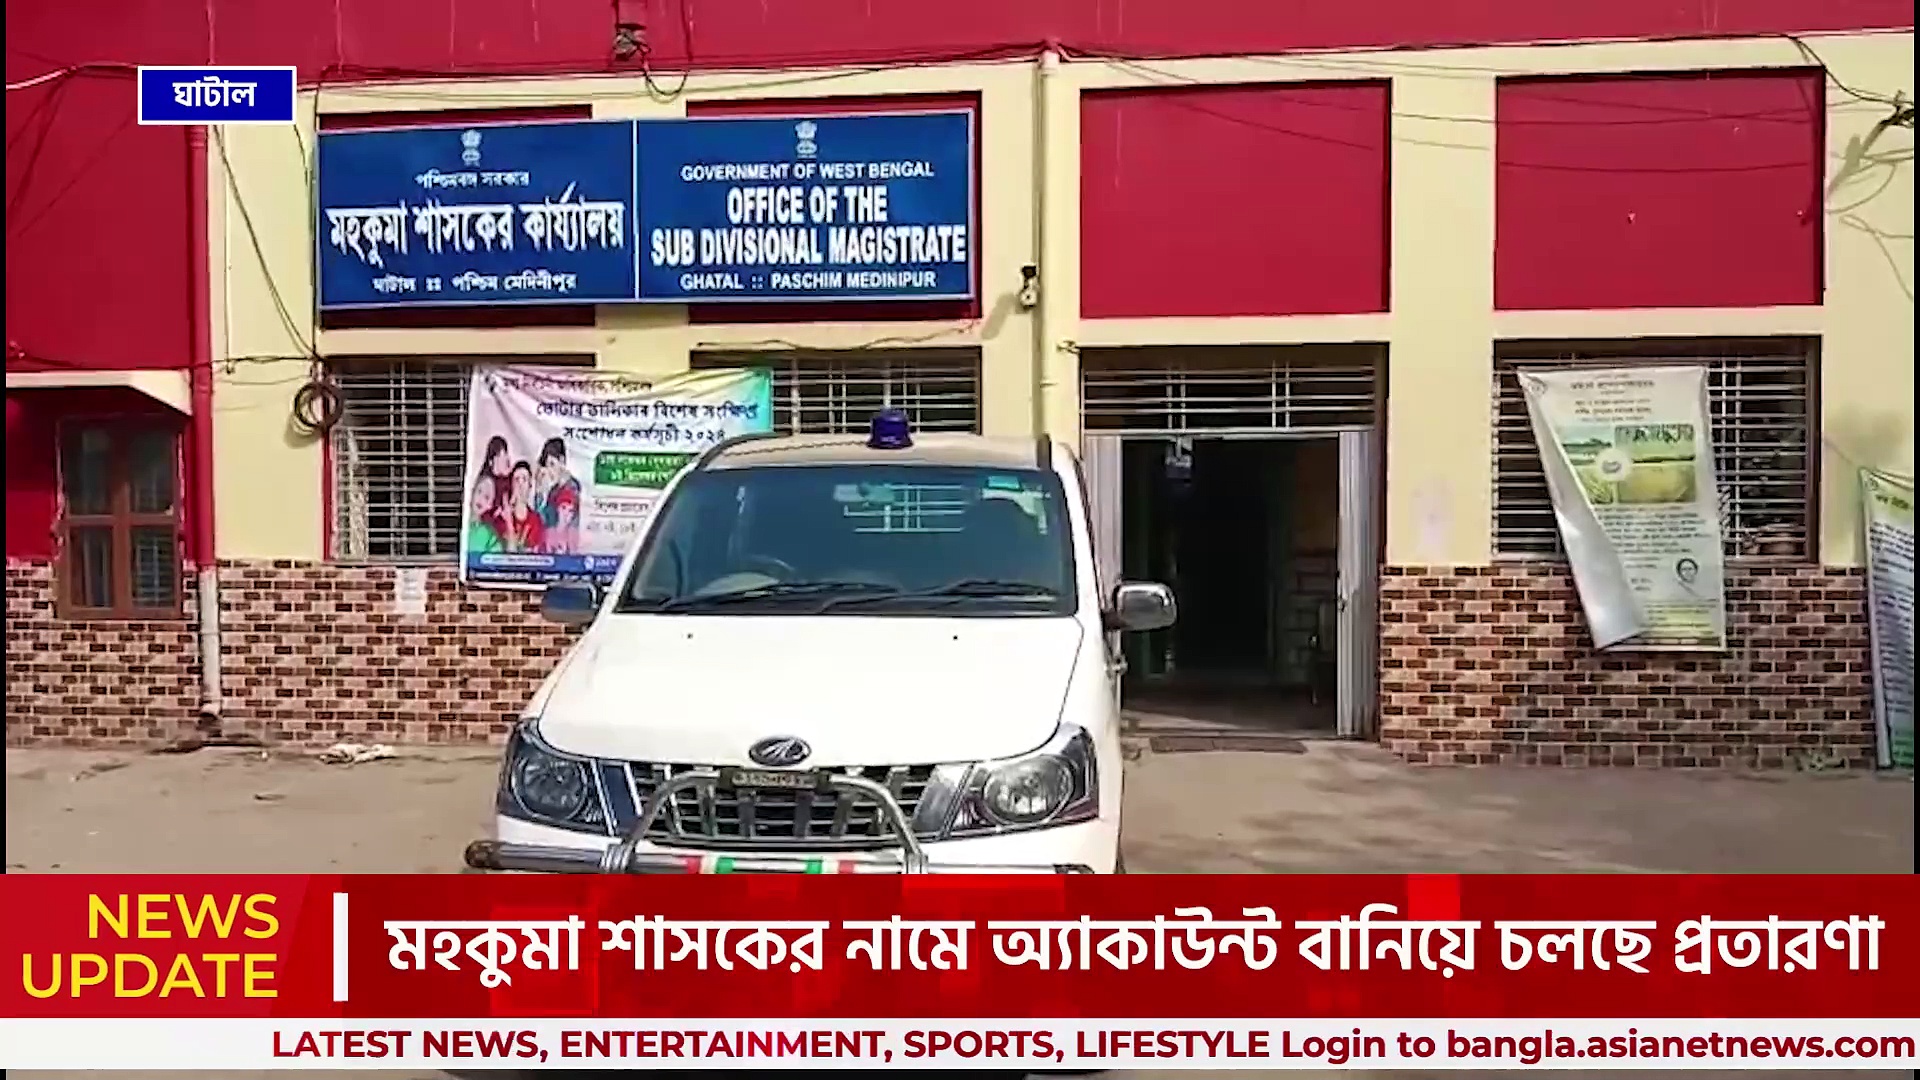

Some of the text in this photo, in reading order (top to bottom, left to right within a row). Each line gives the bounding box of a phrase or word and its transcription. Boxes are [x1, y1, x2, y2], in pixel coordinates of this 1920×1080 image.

[480, 170, 530, 187] সরকার
[680, 161, 935, 181] GOVERNMENT OF WEST BENGAL
[727, 185, 888, 224] OFFICE OF THE
[325, 197, 409, 269] মহকুমা
[412, 196, 514, 255] শাসকের
[651, 224, 966, 266] SUB DIVISIONAL MAGISTRATE
[372, 273, 416, 294] ঘাটাল
[452, 270, 498, 292] পশ্চিম
[504, 268, 577, 294] মেদিনীপুর
[680, 273, 744, 290] GHATAL
[771, 272, 843, 289] PASCHIM
[847, 271, 937, 288] MEDINIPUR
[537, 401, 583, 418] ভোটার
[587, 400, 649, 418] তালিকার
[653, 400, 698, 418] বিশেষ
[562, 424, 625, 441] সংশোধন
